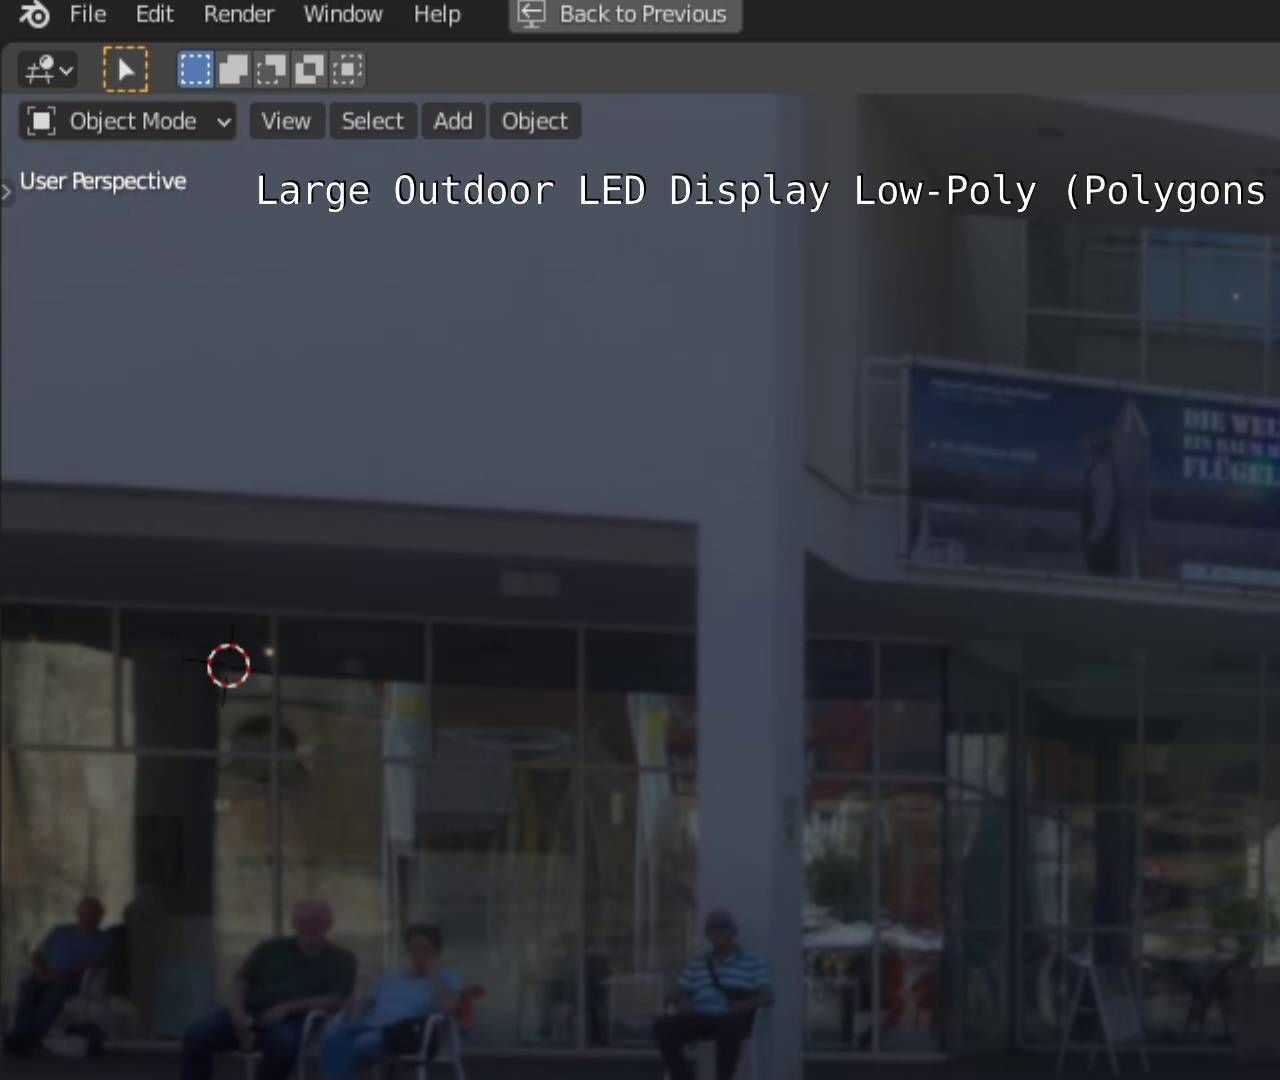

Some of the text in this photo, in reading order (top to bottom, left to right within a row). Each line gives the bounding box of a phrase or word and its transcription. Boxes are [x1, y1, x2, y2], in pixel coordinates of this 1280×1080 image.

[70, 4, 107, 23] File
[136, 4, 174, 23] Edit
[204, 4, 275, 23] Render
[304, 4, 383, 23] Window
[414, 4, 461, 28] Help
[561, 4, 727, 23] Back to Previous
[70, 111, 197, 134] Object Mode
[261, 111, 311, 130] View
[342, 111, 404, 130] Select
[433, 111, 473, 130] Add
[502, 111, 568, 134] Object
[20, 170, 187, 195] User Perspective
[1183, 408, 1225, 432] DIE
